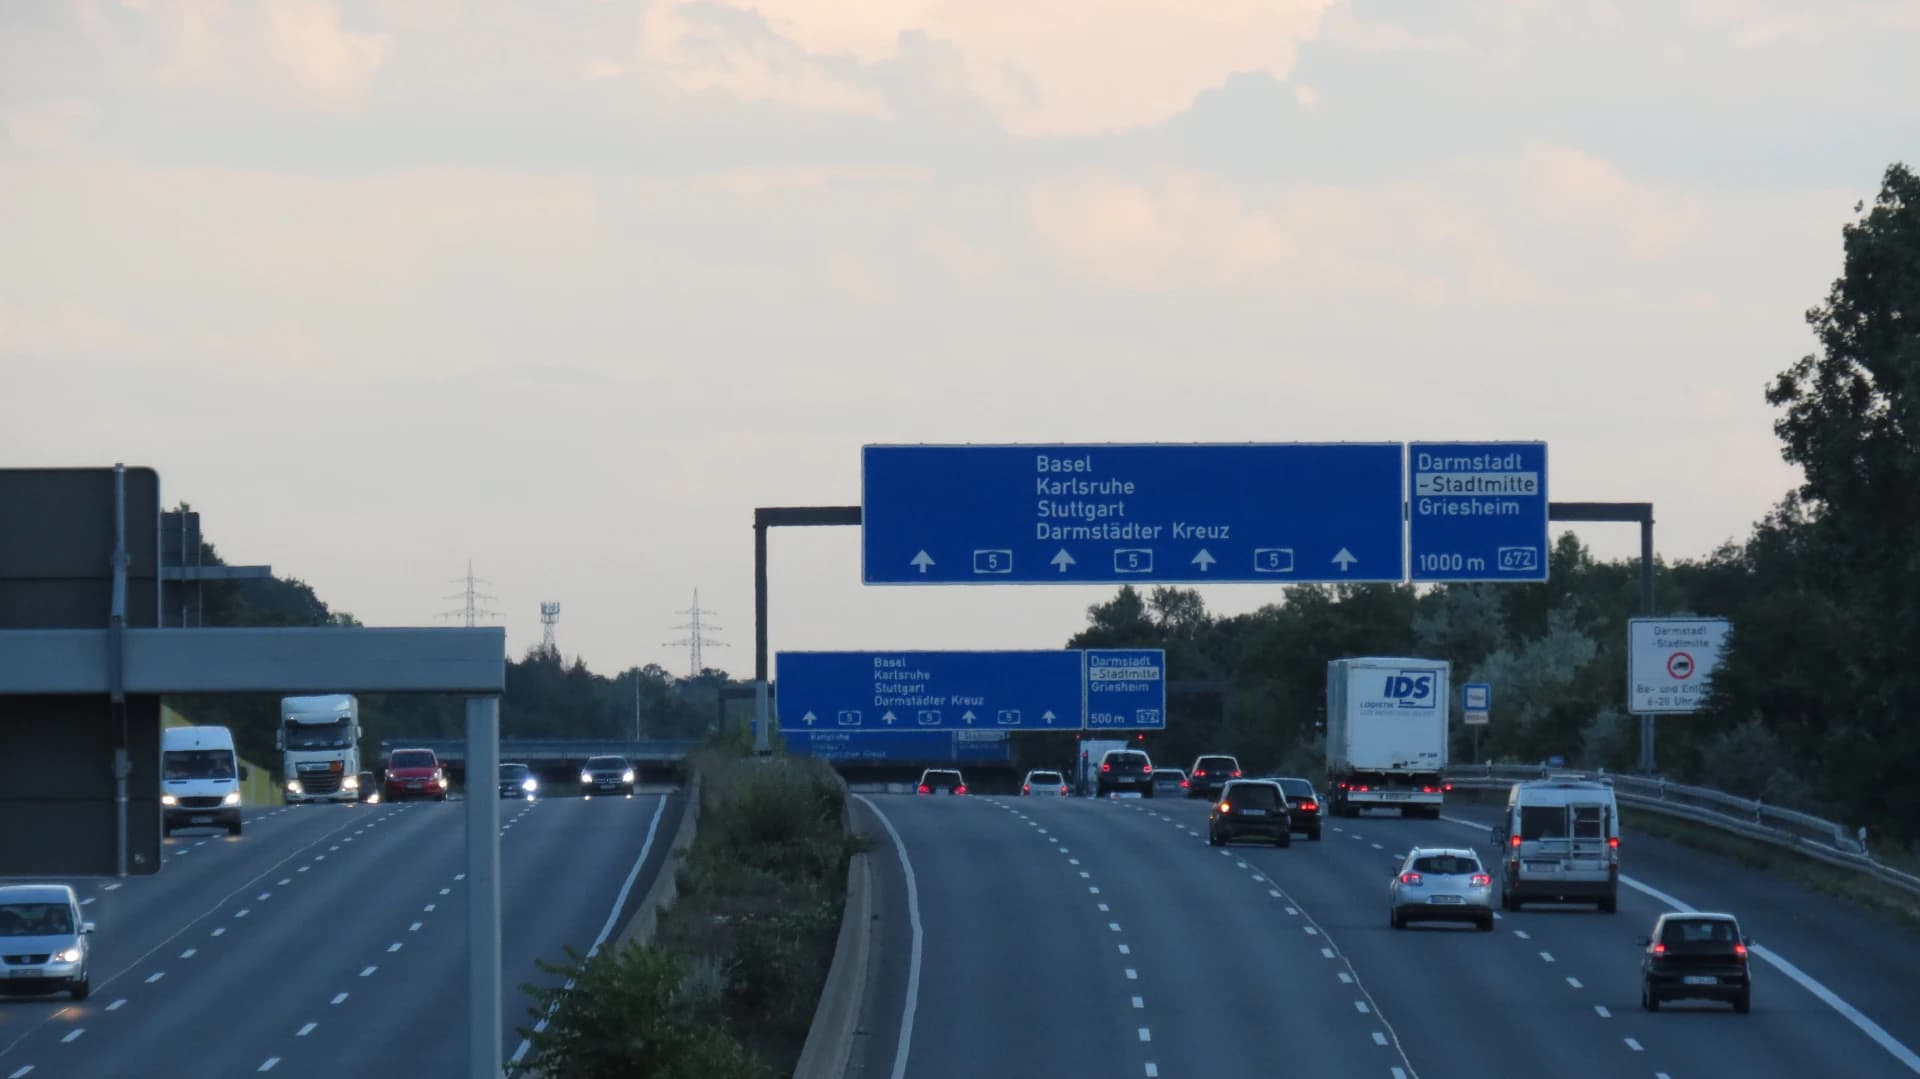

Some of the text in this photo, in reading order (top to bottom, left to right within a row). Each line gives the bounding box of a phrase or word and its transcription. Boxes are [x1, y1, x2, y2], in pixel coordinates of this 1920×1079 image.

[1037, 455, 1092, 473] Basel
[1418, 453, 1522, 470] Darmstadt
[1037, 478, 1135, 496] Karlsruhe
[1037, 500, 1125, 520] Stuttgart
[1418, 498, 1520, 515] Griesheim
[1037, 522, 1230, 541] Darmstädter Kreuz
[988, 553, 998, 569] 5
[1129, 553, 1139, 569] 5
[1269, 553, 1279, 569] 5
[1420, 554, 1485, 571] 1000 m
[1503, 551, 1532, 566] 672
[874, 657, 906, 667] Basel
[1091, 655, 1151, 666] Darmstadt
[874, 670, 931, 680] Karlsruhe
[874, 682, 925, 695] Stuttgart
[1091, 681, 1149, 692] Griesheim
[1384, 675, 1431, 699] IDS
[874, 695, 985, 706] Darmstädter Kreuz
[1091, 713, 1125, 724] 500 m
